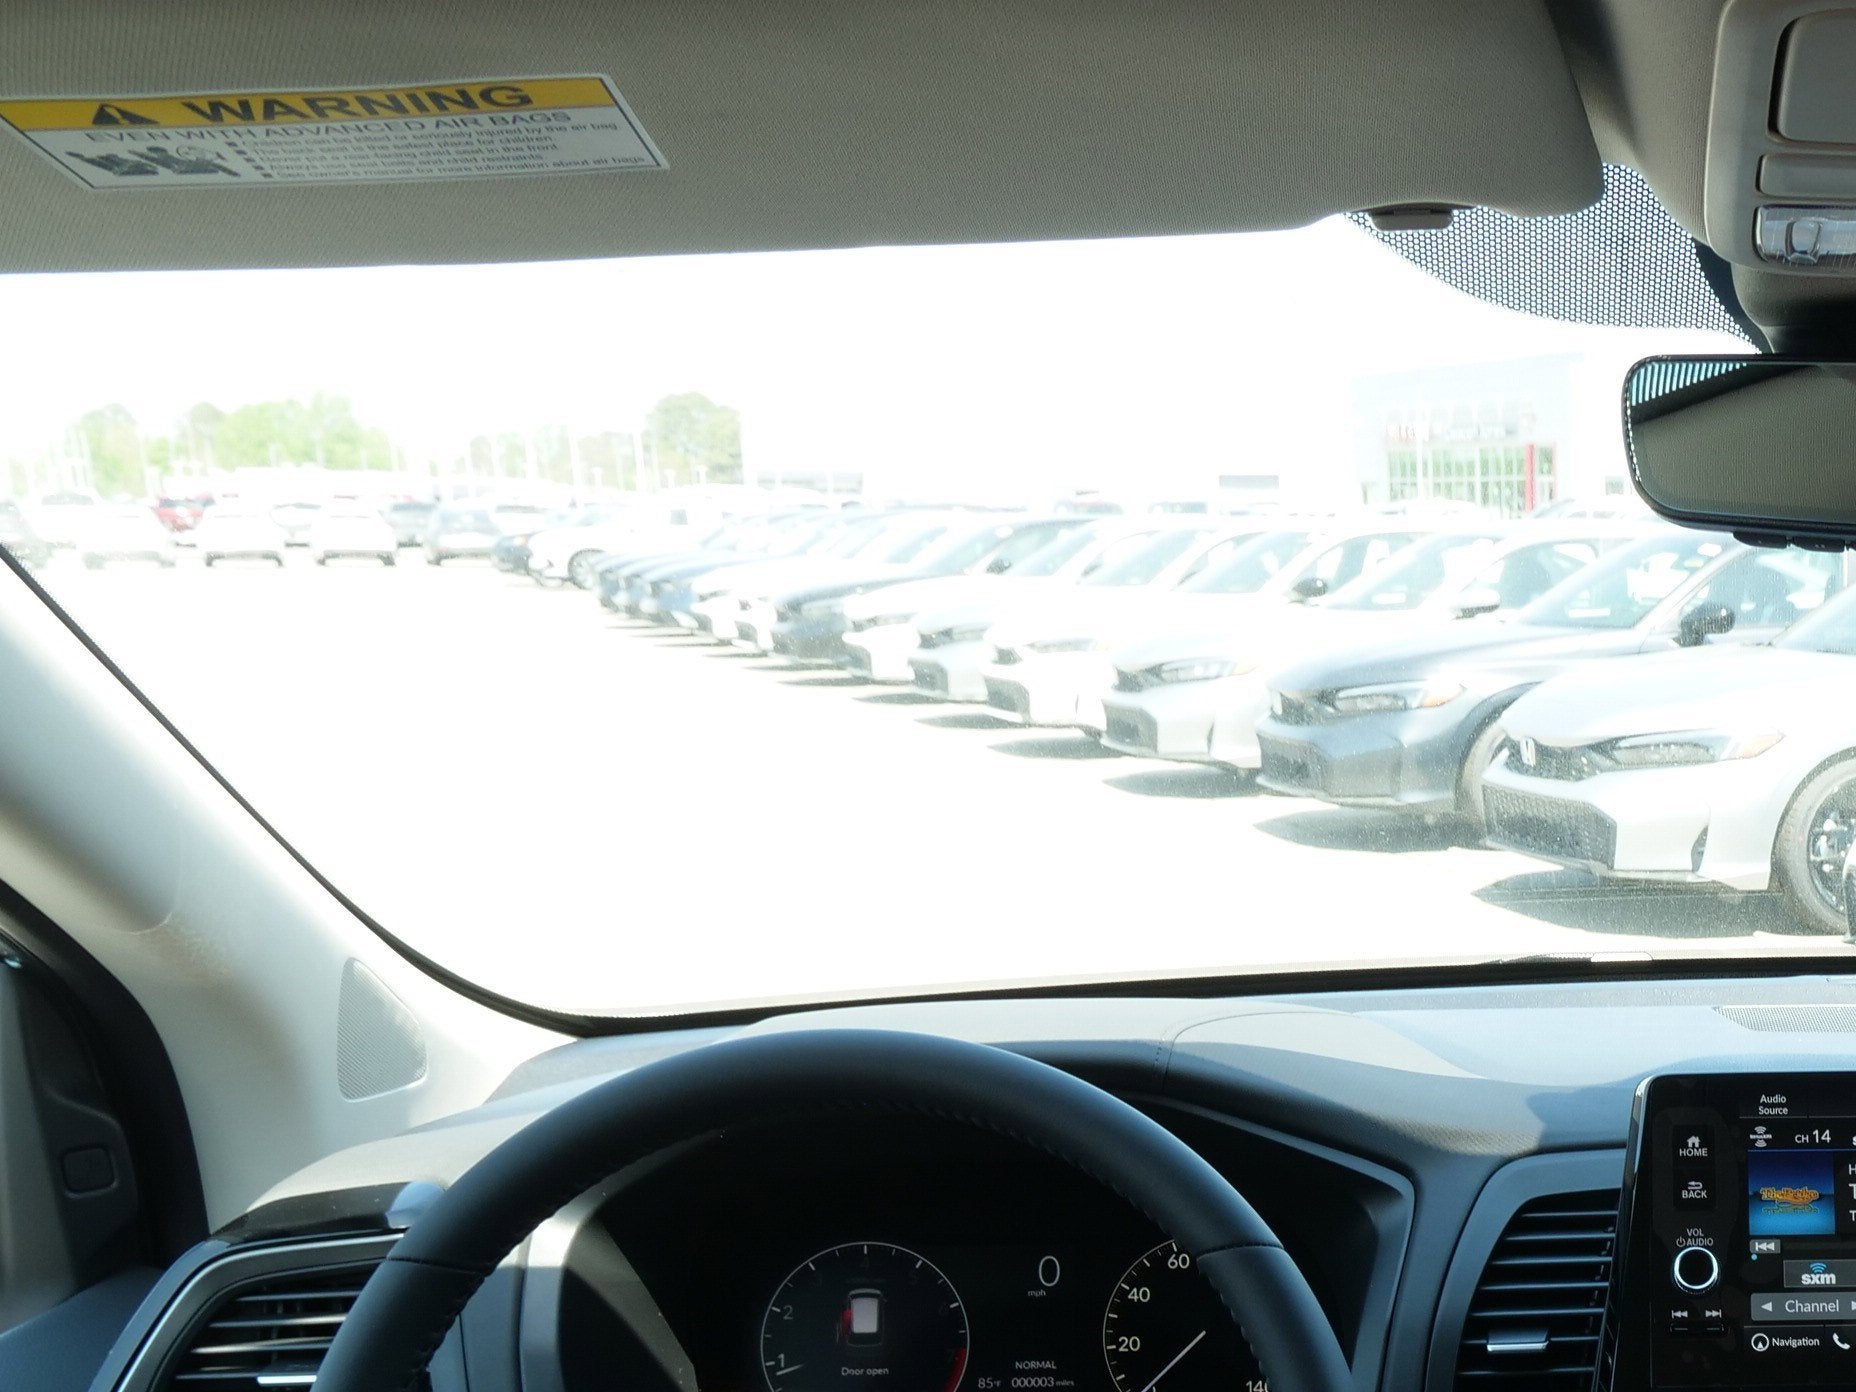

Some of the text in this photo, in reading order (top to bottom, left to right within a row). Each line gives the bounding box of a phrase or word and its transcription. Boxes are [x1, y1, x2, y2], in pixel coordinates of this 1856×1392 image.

[181, 85, 534, 123] WARNING
[84, 110, 573, 143] EVEN WITH ADVANCED AIR BAGS
[1760, 1094, 1787, 1104] Audio
[1758, 1105, 1789, 1116] Source
[1795, 1129, 1832, 1144] CH 14
[1679, 1147, 1708, 1157] HOME
[1681, 1189, 1708, 1199] BACK
[1686, 1227, 1705, 1237] VOL
[1686, 1237, 1714, 1247] AUDIO
[1167, 1252, 1190, 1270] 60
[1038, 1253, 1061, 1288] 0
[1027, 1288, 1047, 1299] mph
[1127, 1286, 1151, 1303] 40
[782, 1304, 794, 1321] 2
[1785, 1299, 1840, 1313] Channel
[1117, 1335, 1141, 1353] 20
[1771, 1336, 1820, 1348] Navigation
[777, 1353, 786, 1368] 1
[1014, 1360, 1057, 1370] NORMAL
[840, 1366, 890, 1379] Door open
[1011, 1377, 1055, 1388] 000003
